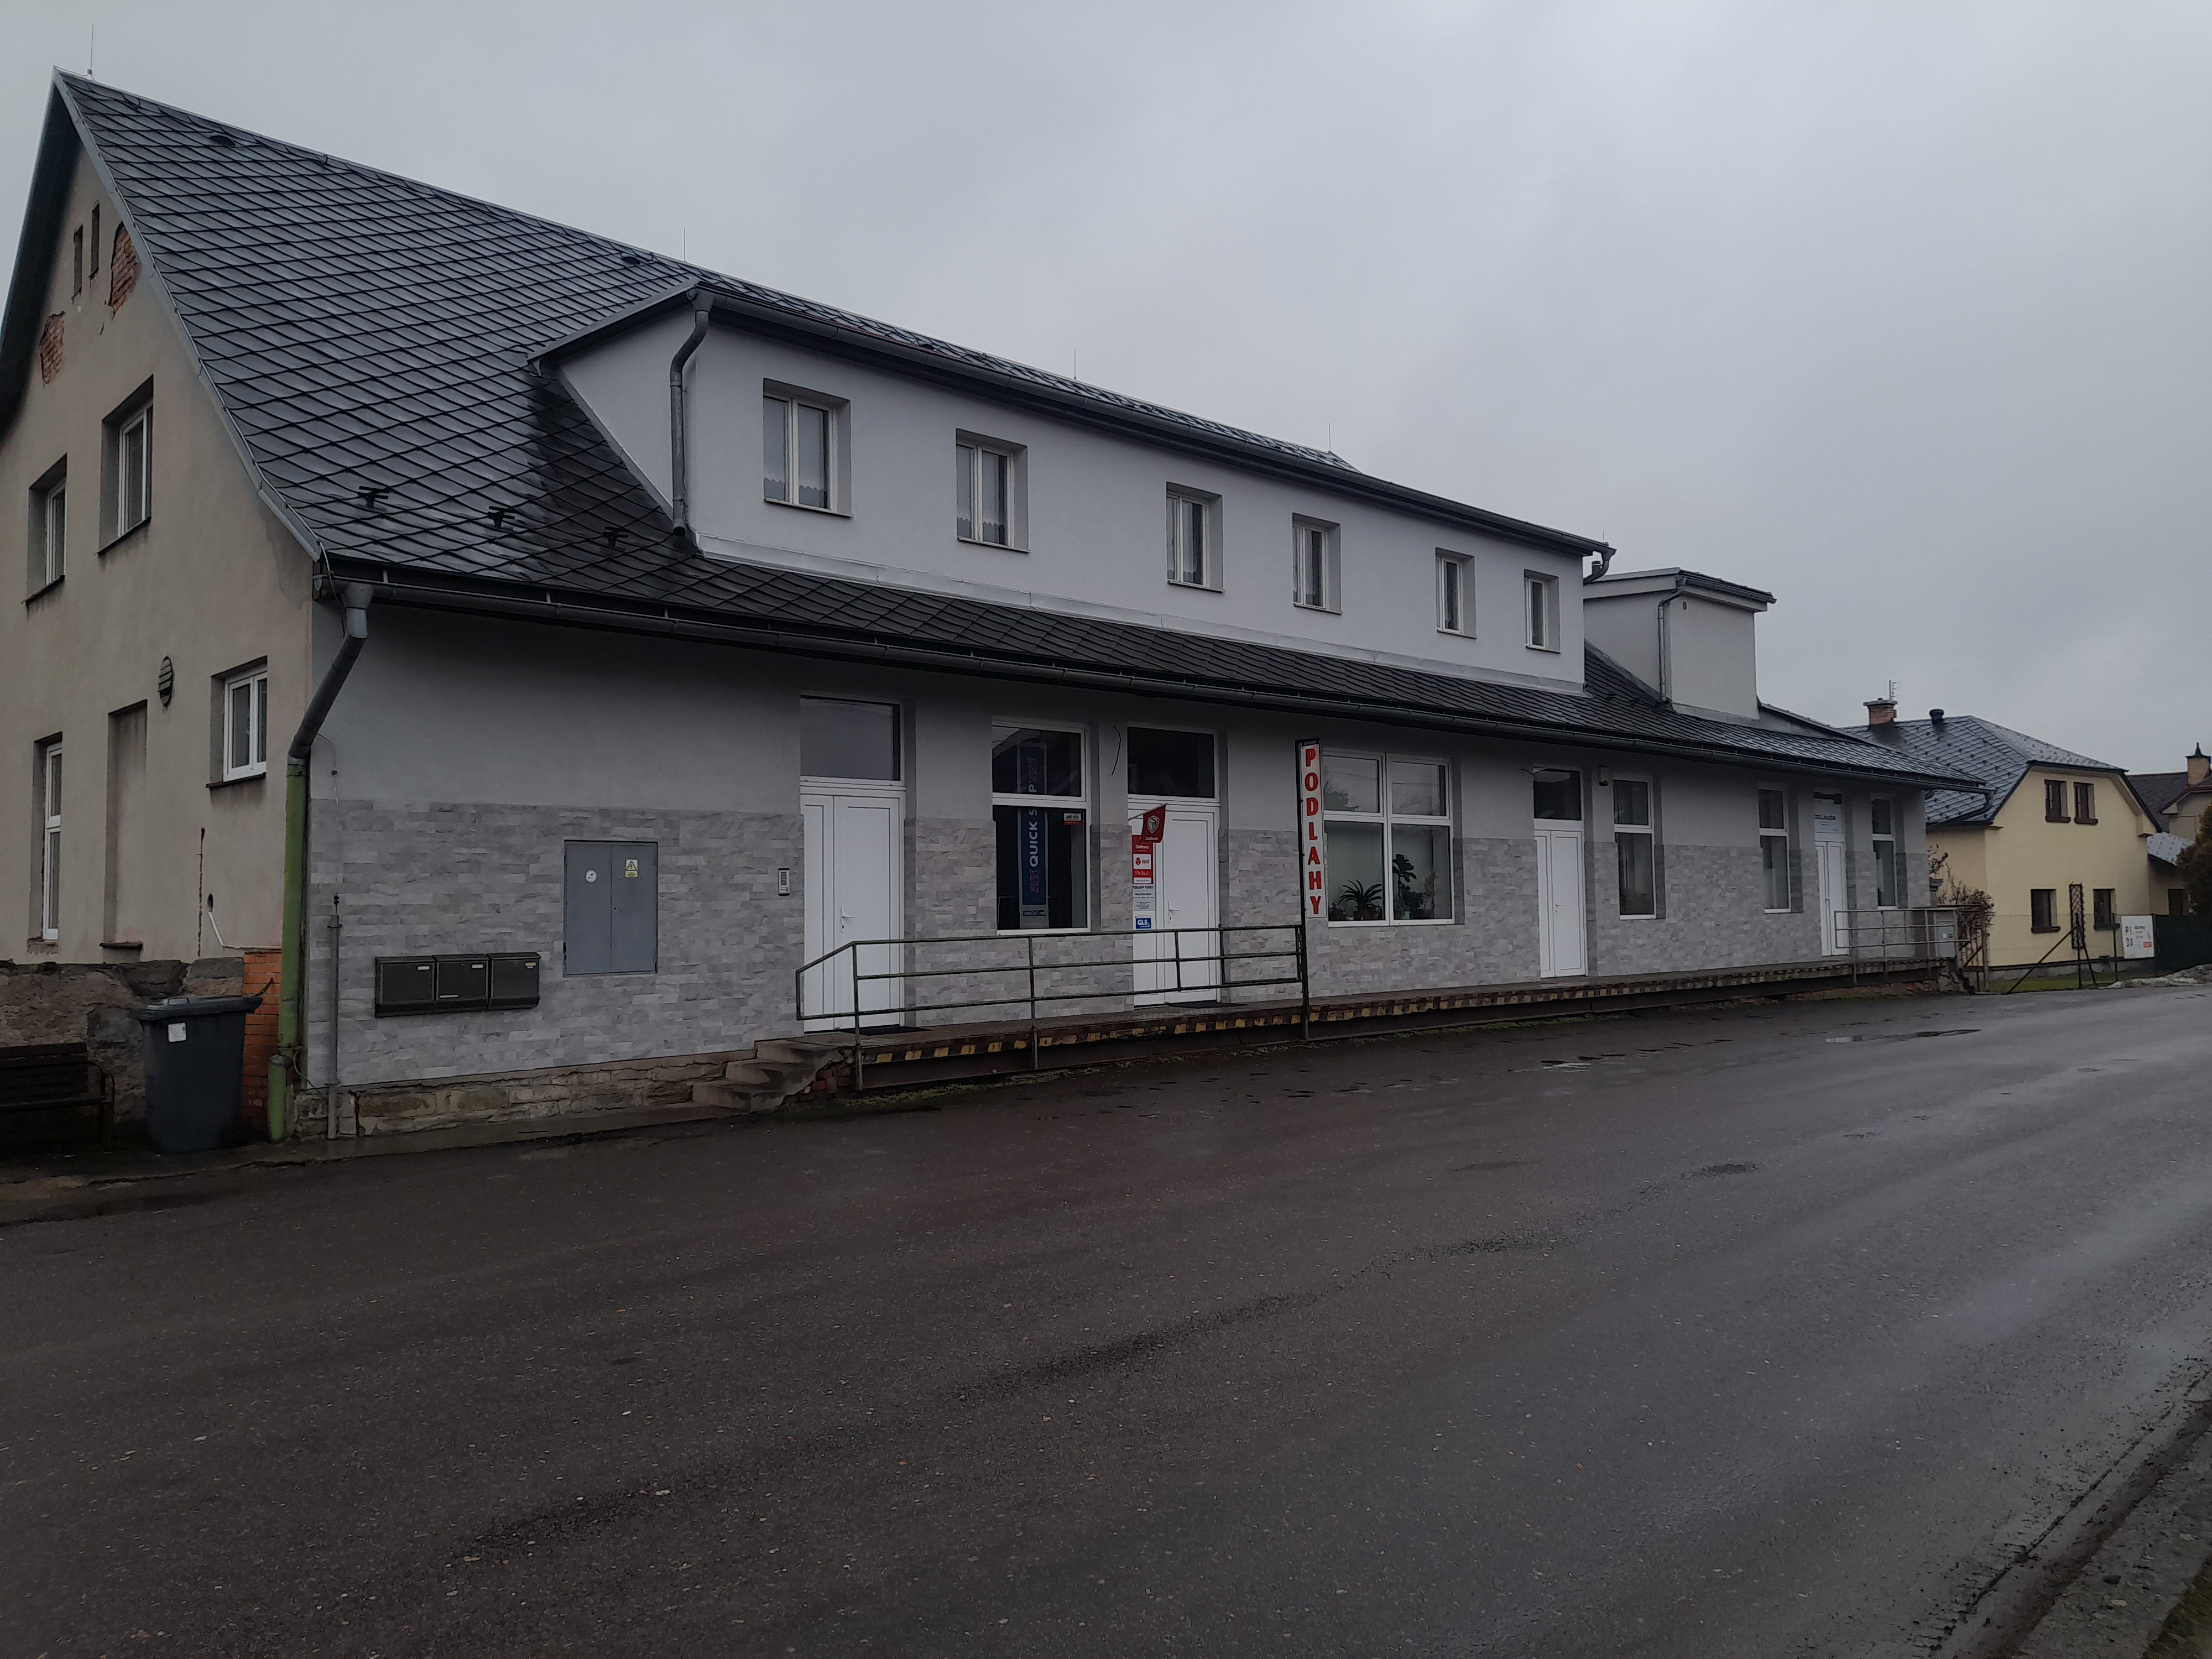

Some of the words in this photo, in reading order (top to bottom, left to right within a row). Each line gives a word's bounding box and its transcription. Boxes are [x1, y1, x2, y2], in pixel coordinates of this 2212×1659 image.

[1029, 784, 1038, 816] SP
[1029, 821, 1039, 868] QUICK
[1305, 748, 1322, 915] PODLAHY
